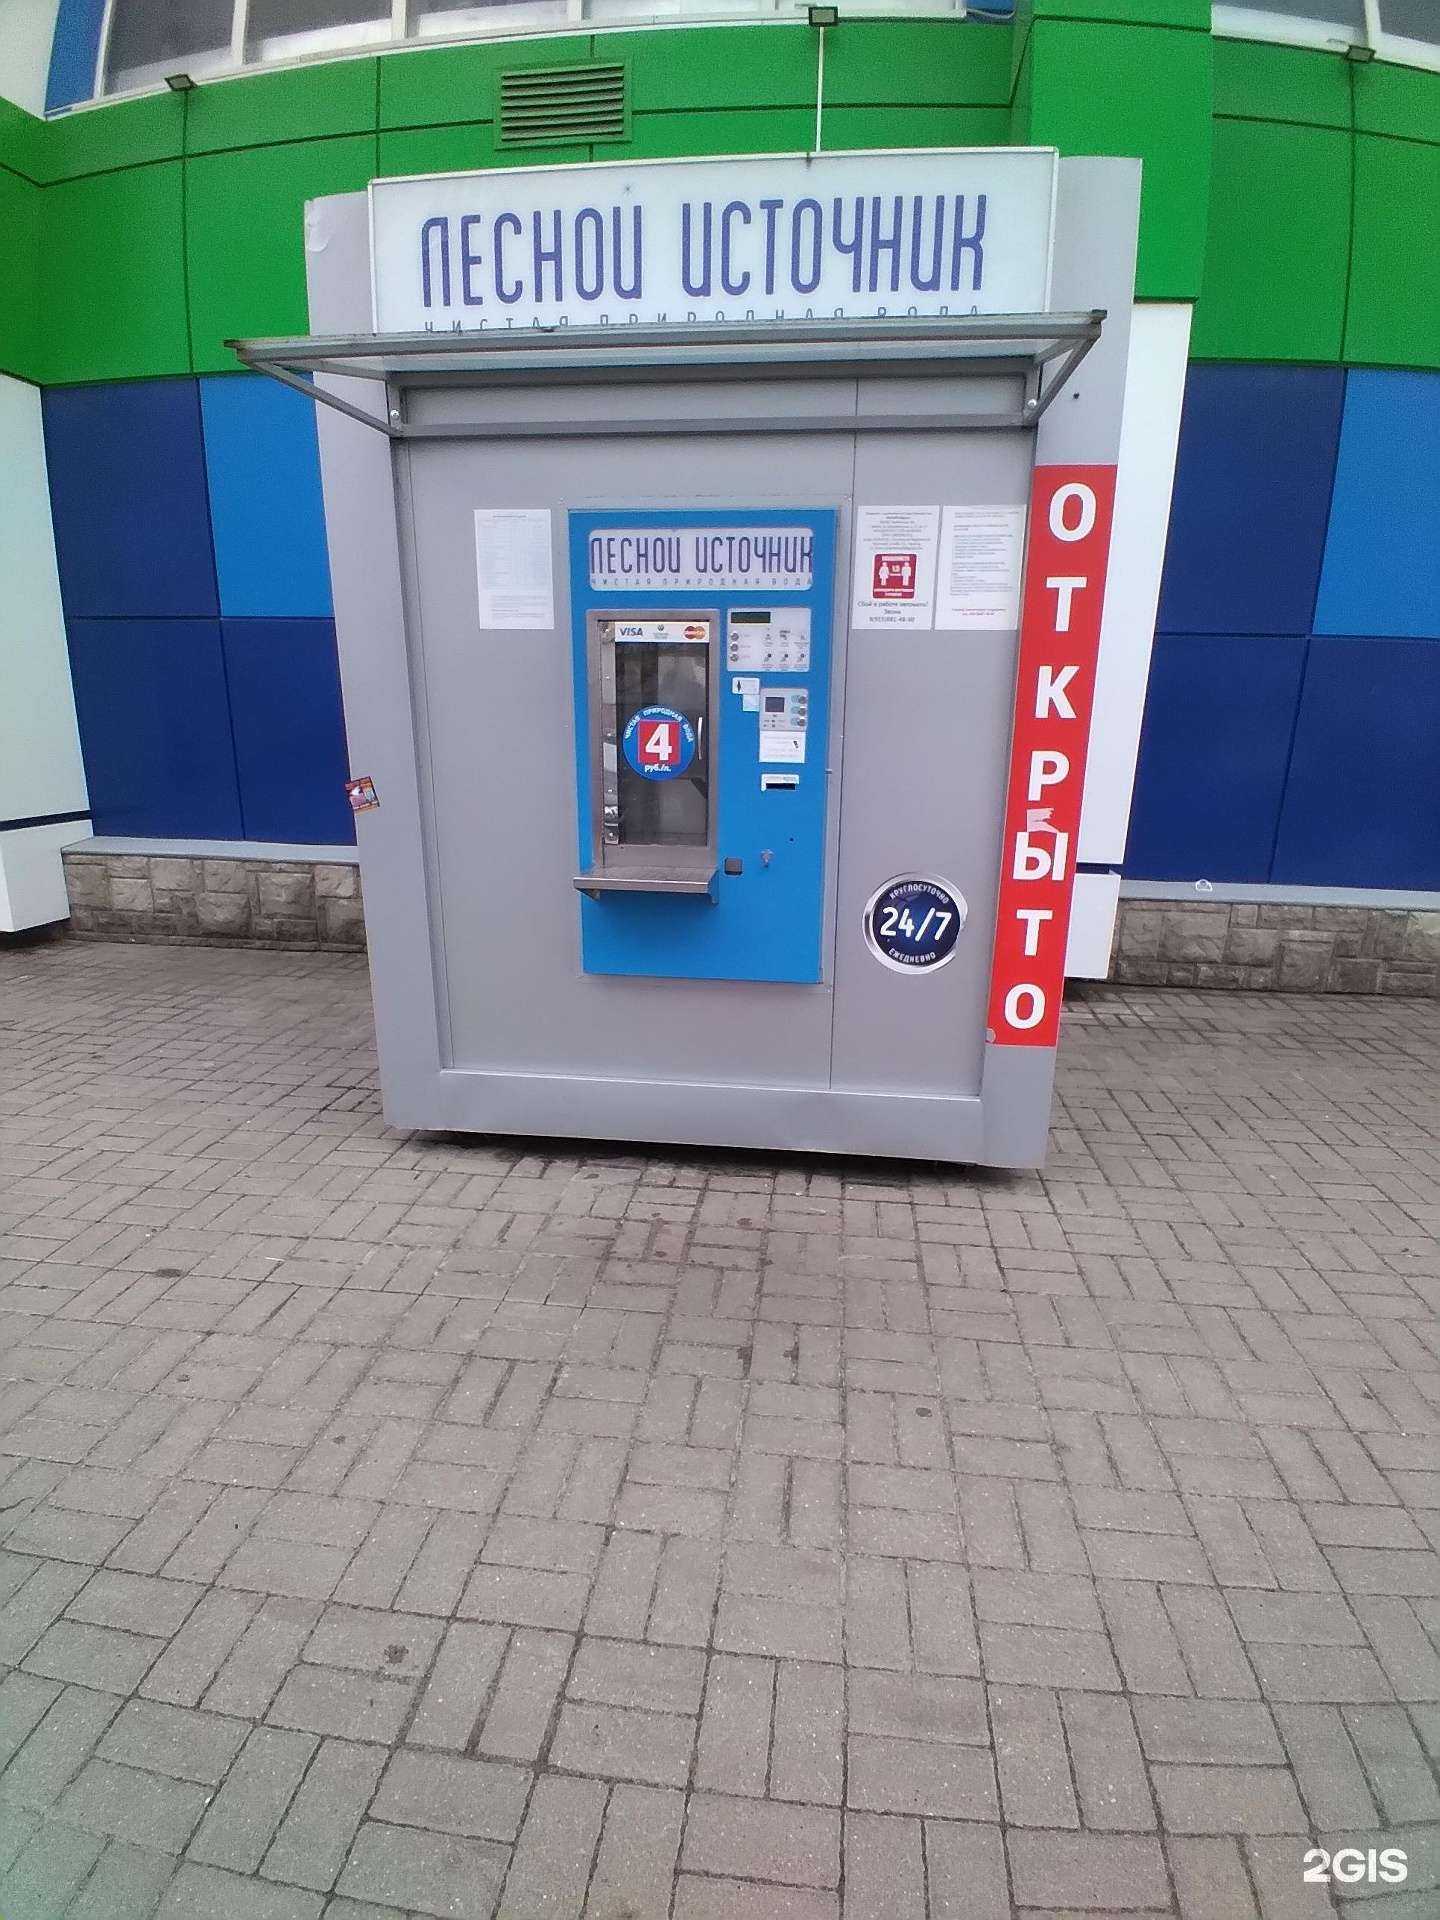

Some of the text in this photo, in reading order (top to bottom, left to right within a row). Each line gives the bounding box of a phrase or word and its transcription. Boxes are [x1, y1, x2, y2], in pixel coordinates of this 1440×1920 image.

[682, 194, 987, 298] ИСТОЧНИК
[619, 627, 644, 637] VISA
[645, 723, 673, 760] 4
[1003, 482, 1098, 1030] ОТКРЫТО
[889, 884, 949, 904] КРУГЛОСУТОЧНО
[880, 906, 952, 941] 24/7
[888, 947, 936, 963] ЕЖЕДНЕВНО
